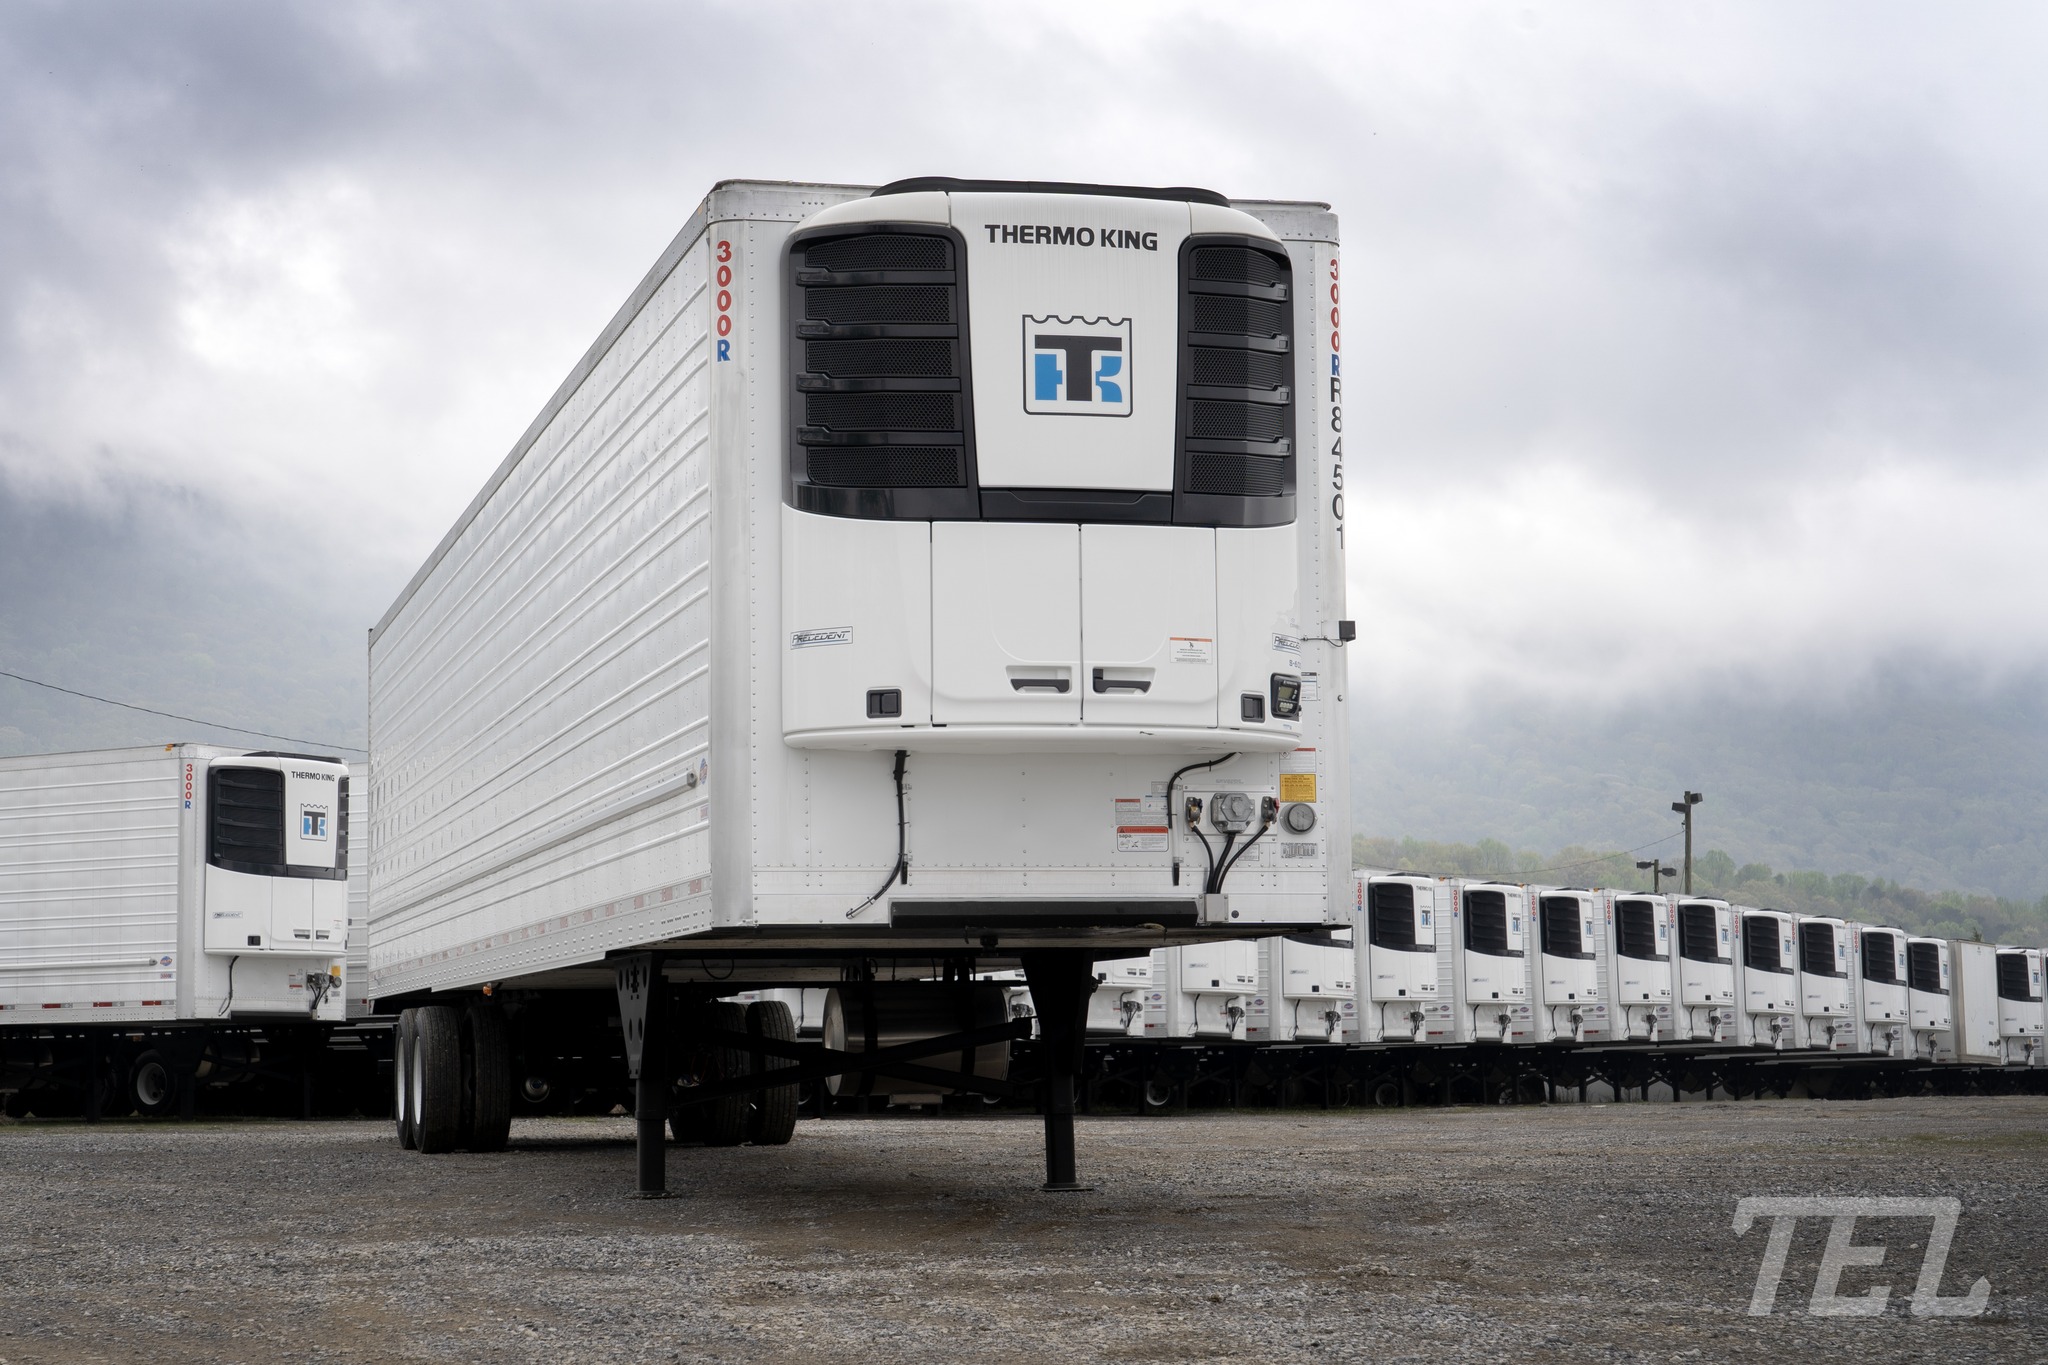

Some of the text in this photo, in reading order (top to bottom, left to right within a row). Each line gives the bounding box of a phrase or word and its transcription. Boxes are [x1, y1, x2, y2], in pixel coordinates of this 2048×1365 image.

[984, 224, 1158, 251] THERMO KING
[716, 240, 732, 362] 3000R
[1329, 258, 1340, 377] 3000R
[1330, 376, 1344, 550] R84501
[791, 630, 851, 644] PRECEDENT
[185, 763, 193, 809] 3000R
[291, 771, 335, 782] THERMO KING
